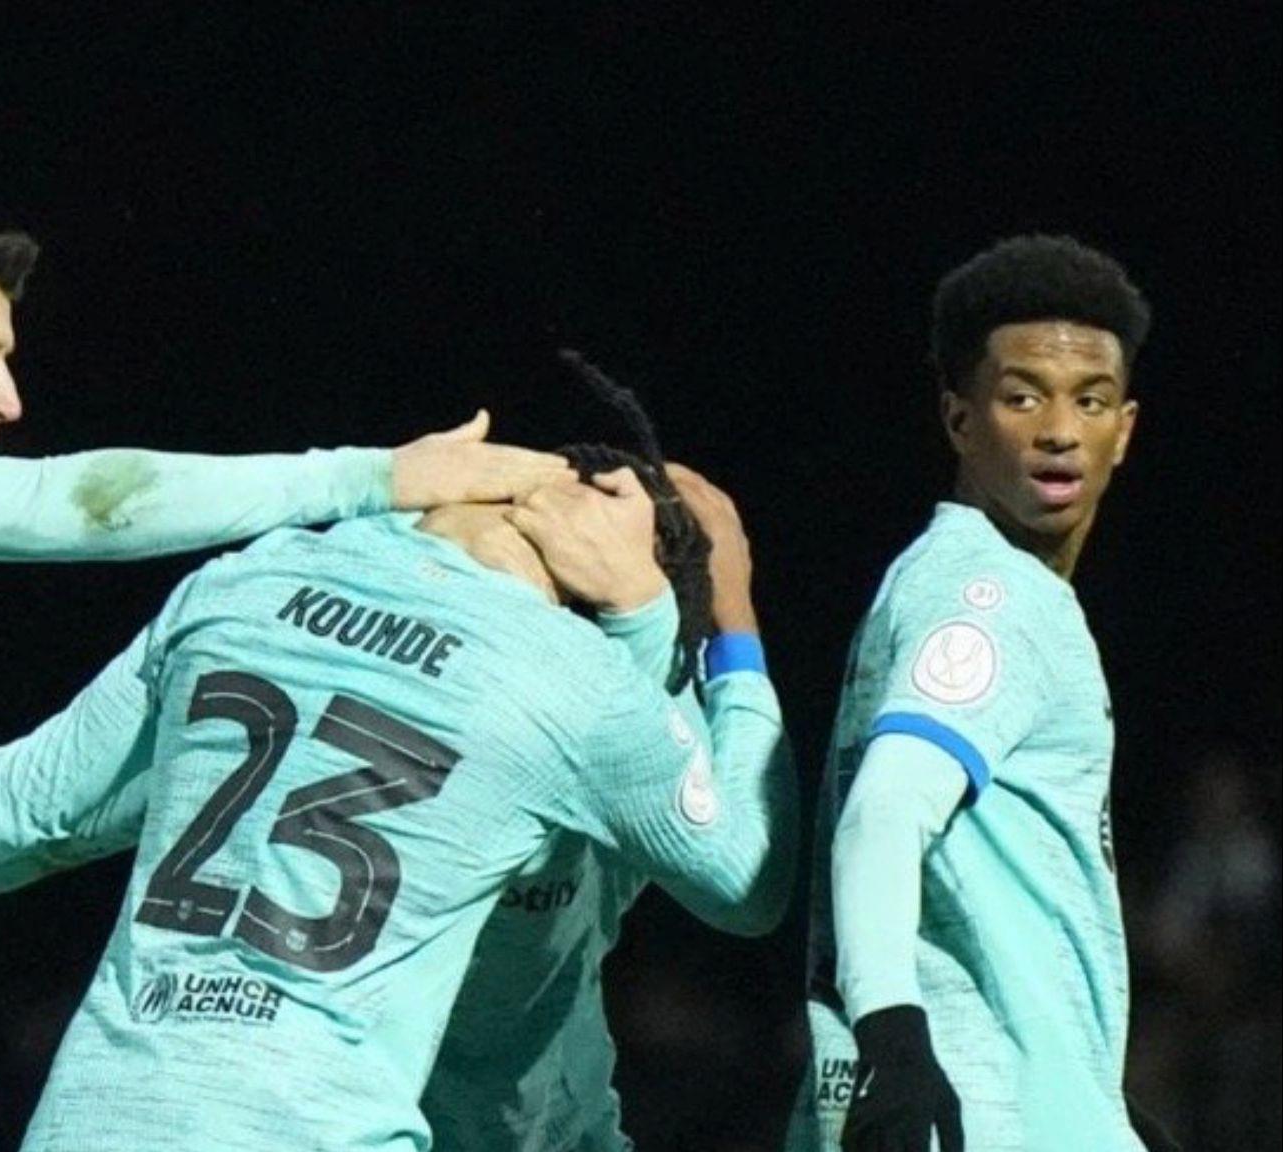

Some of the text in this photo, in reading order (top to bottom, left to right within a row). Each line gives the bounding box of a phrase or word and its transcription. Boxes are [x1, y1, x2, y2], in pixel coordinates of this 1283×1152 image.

[276, 586, 464, 679] KOUNDE
[135, 670, 464, 974] 23
[176, 993, 278, 1022] ACNUR
[184, 973, 283, 1009] UNHCR
